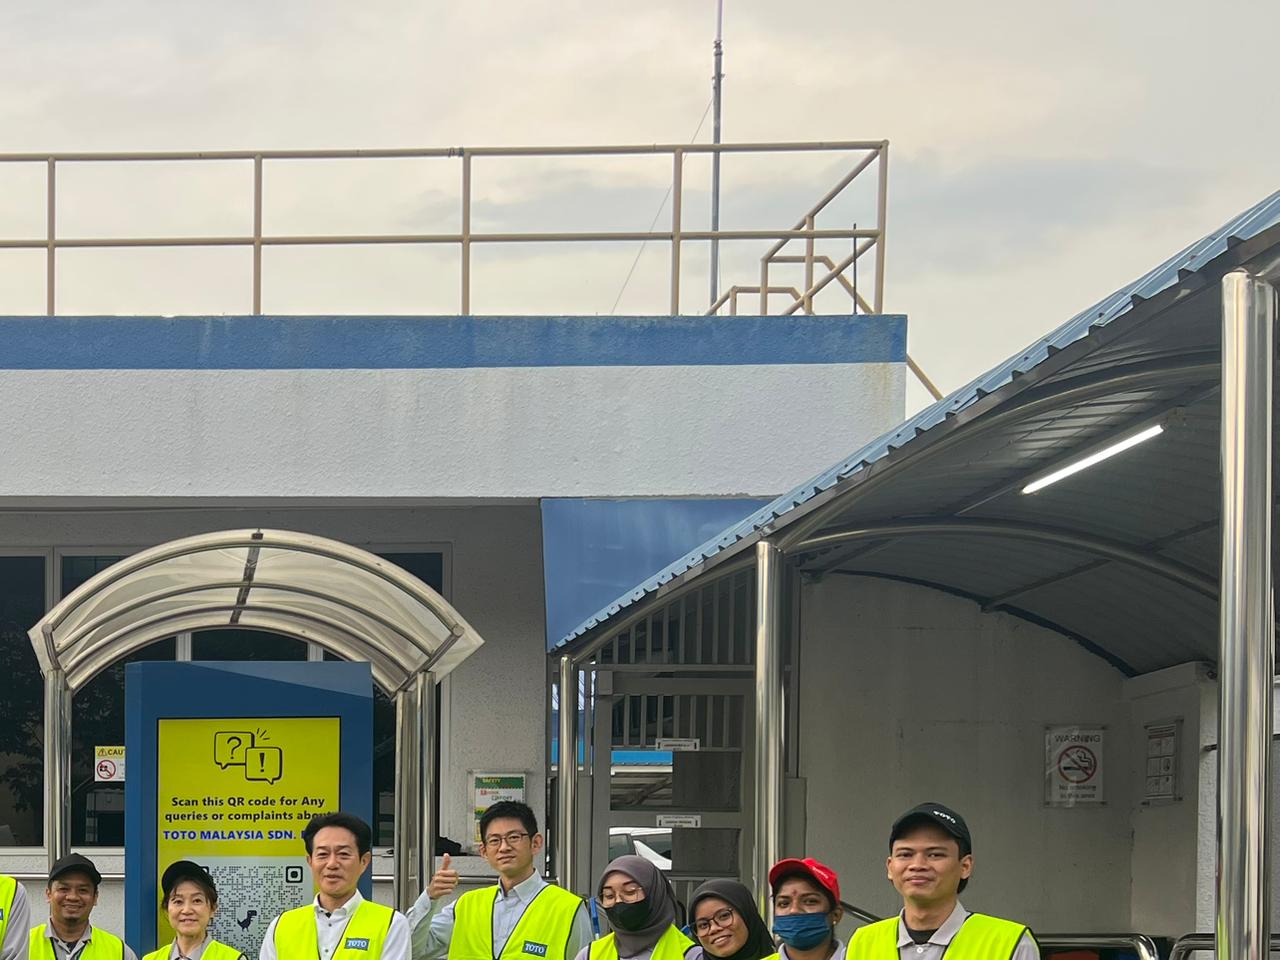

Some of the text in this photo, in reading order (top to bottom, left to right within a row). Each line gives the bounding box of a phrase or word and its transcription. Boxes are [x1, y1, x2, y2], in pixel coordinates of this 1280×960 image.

[1055, 735, 1101, 743] WARNING
[172, 796, 325, 808] Scan this QR code for Any
[165, 810, 208, 823] queries
[211, 812, 224, 820] or
[228, 810, 293, 822] complaints
[163, 830, 197, 840] TOTO
[200, 830, 264, 840] MALAYSIA
[267, 830, 297, 840] SDN.
[347, 940, 367, 948] TOTO
[525, 943, 545, 954] TOTO
